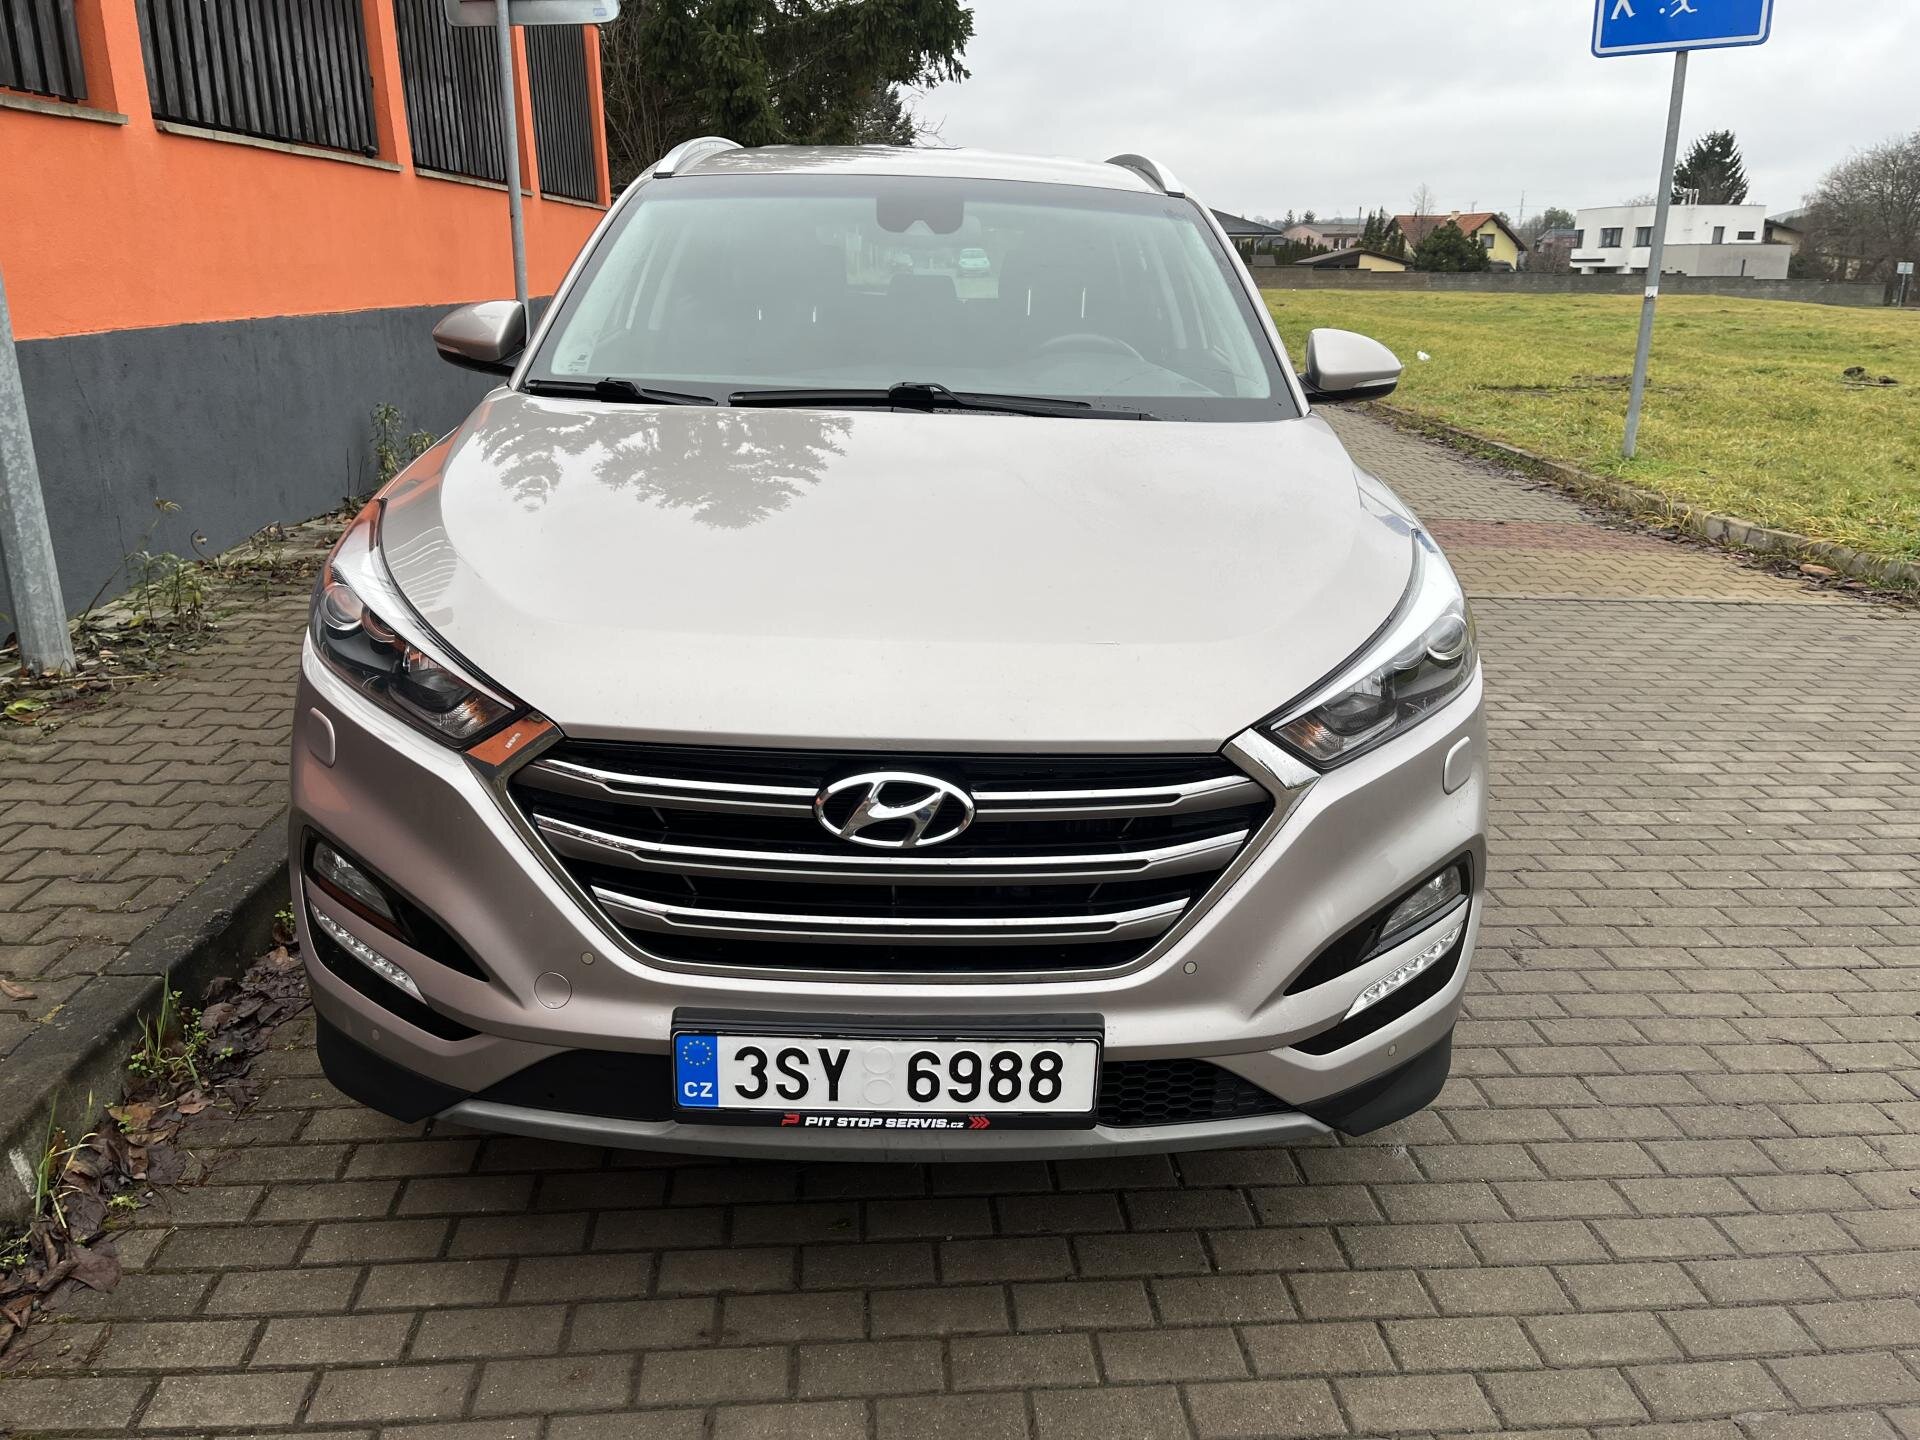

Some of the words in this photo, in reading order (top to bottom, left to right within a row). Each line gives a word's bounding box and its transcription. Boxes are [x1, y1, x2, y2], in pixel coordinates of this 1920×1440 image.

[734, 1046, 850, 1101] 3SY
[907, 1051, 1063, 1103] 6988
[684, 1081, 713, 1098] CZ
[804, 1116, 834, 1127] PIT
[836, 1117, 883, 1128] STOP
